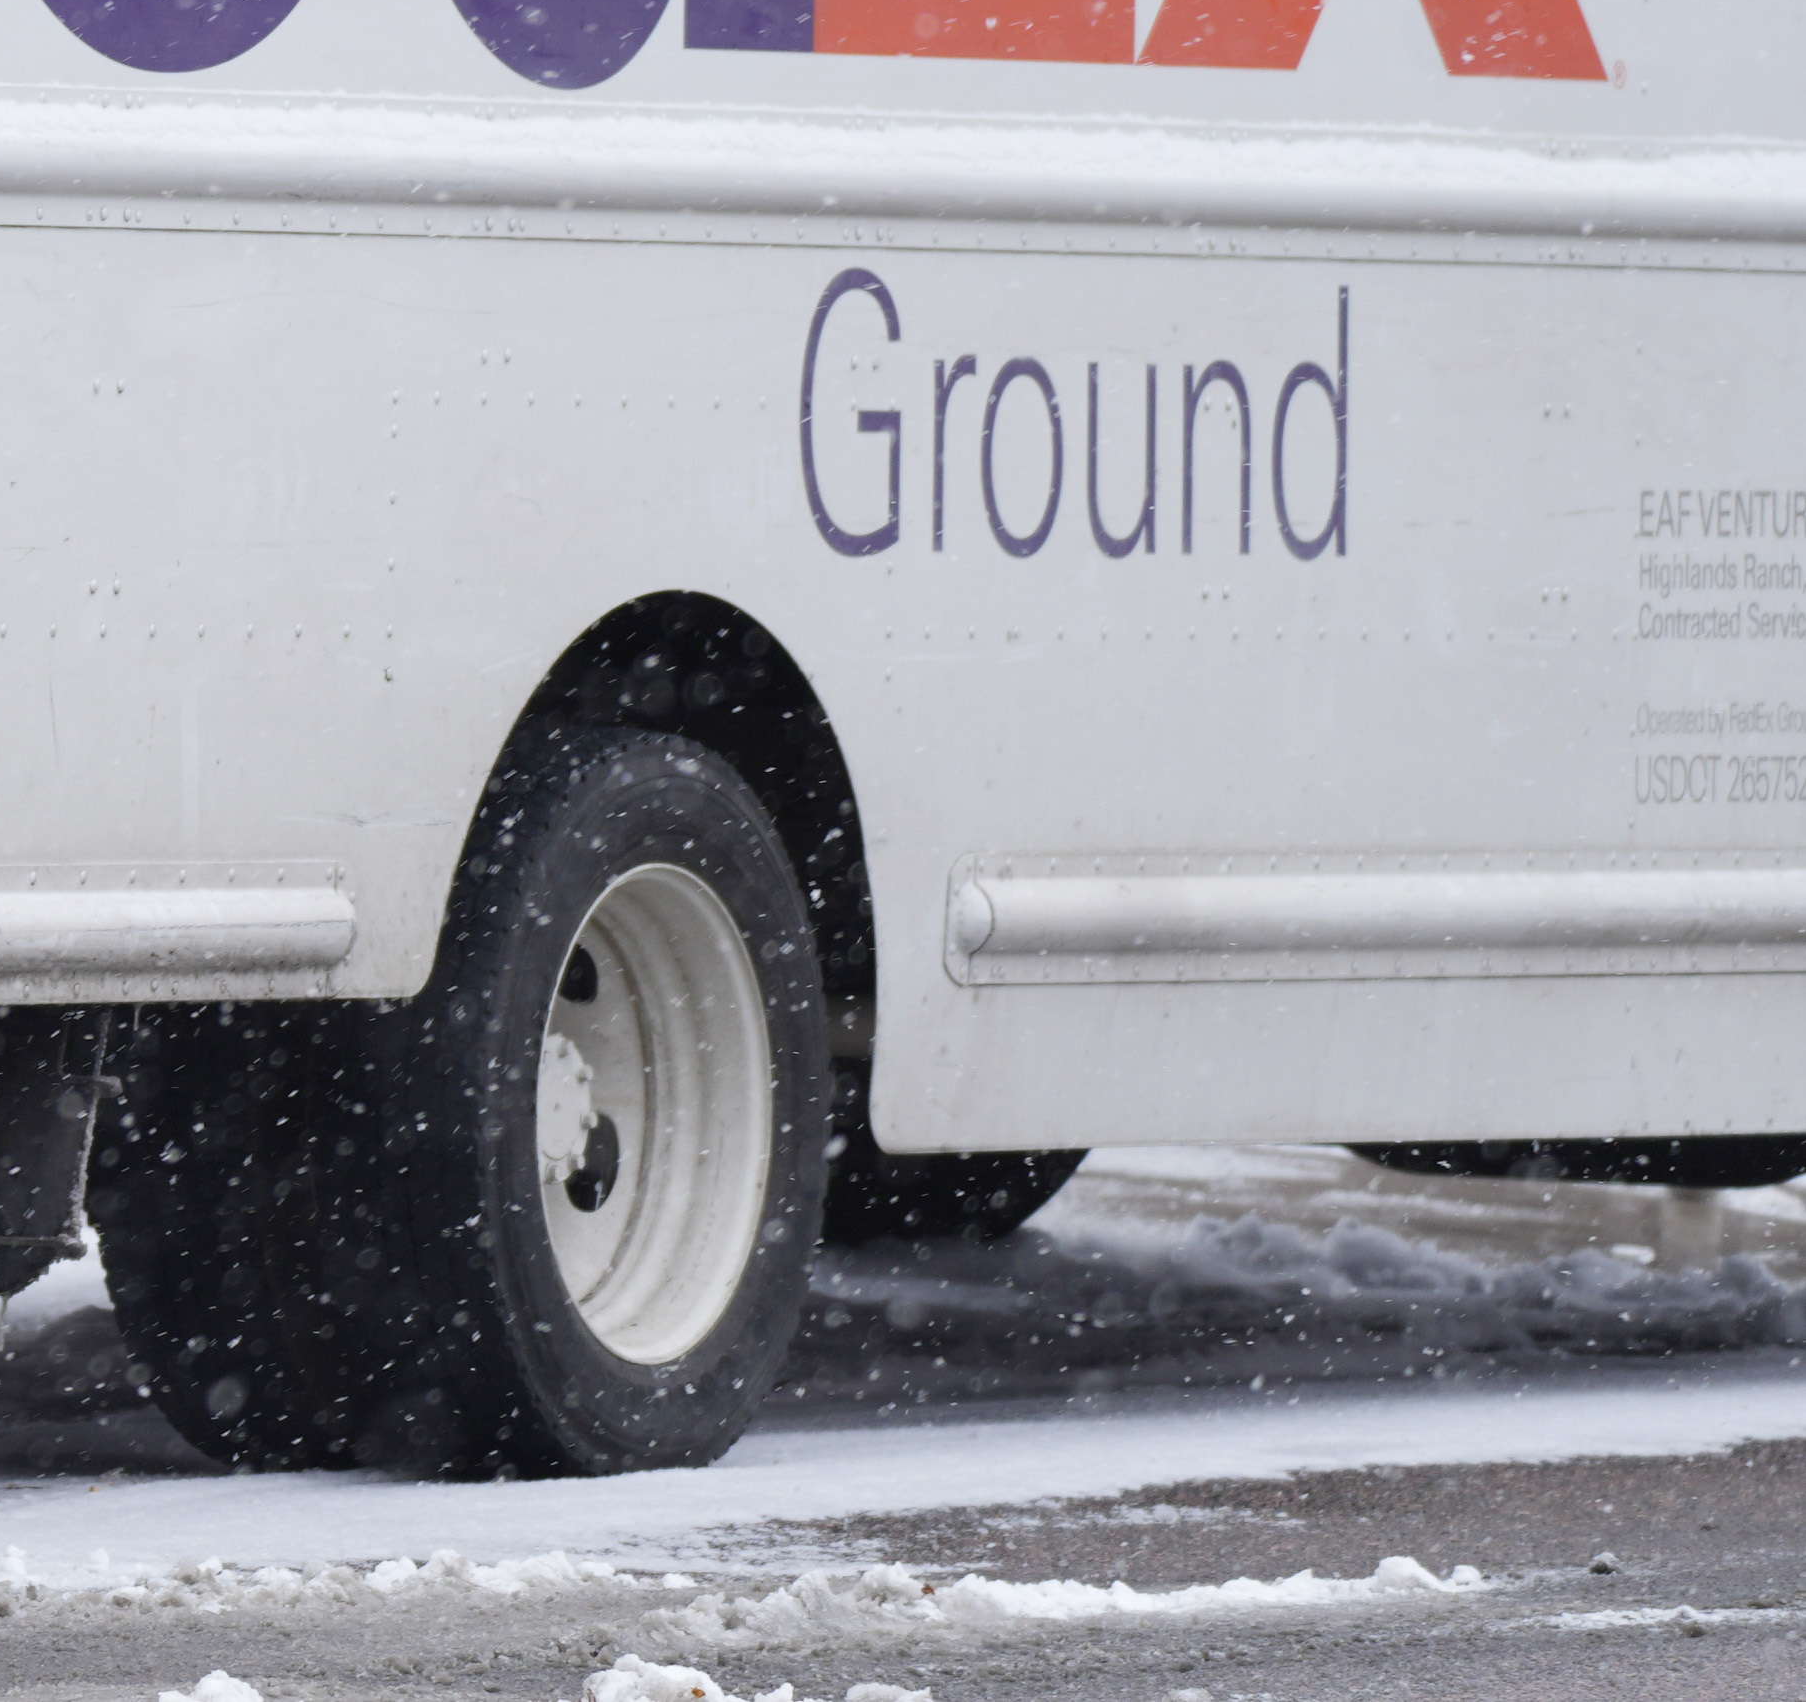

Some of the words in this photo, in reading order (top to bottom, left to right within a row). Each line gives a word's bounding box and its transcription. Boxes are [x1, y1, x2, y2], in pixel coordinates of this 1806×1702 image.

[799, 267, 1349, 562] Ground
[1639, 490, 1692, 538] EAF
[1638, 553, 1737, 599] Highlands
[1638, 602, 1741, 640] Contracted
[1634, 753, 1722, 804] USDOT
